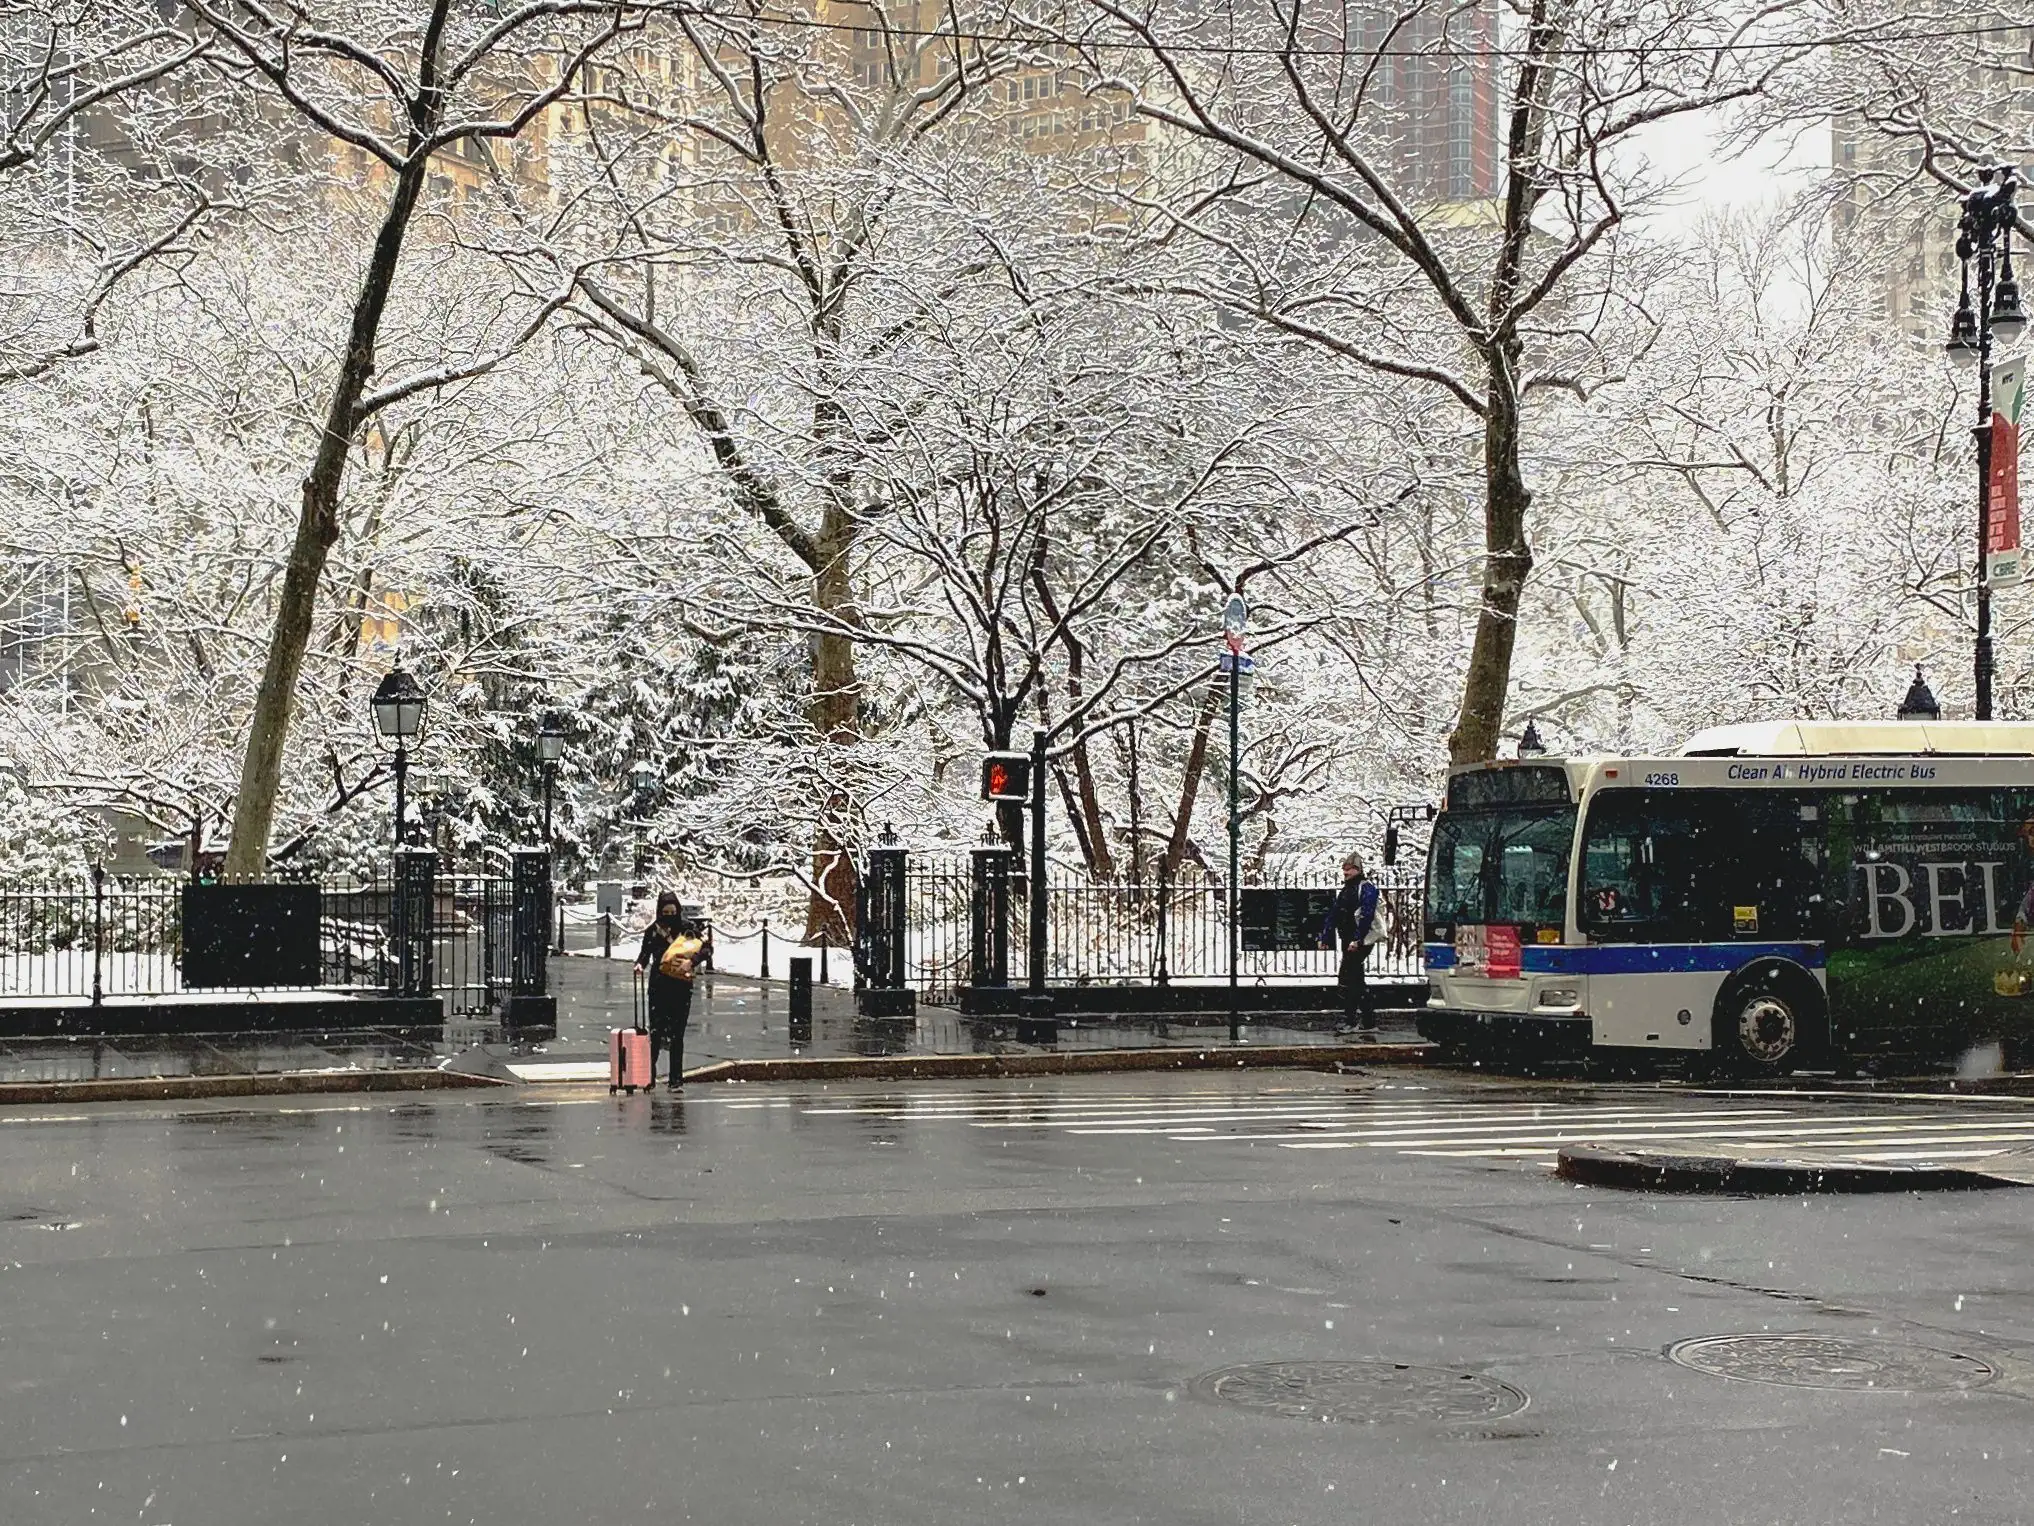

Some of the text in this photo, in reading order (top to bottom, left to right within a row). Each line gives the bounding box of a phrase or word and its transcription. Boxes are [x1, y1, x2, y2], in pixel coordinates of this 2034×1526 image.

[1992, 560, 2017, 577] CBRE
[1644, 772, 1679, 786] 4268
[1727, 764, 1768, 779] Clean
[1798, 764, 1847, 783] Hybrid
[1851, 763, 1905, 779] Electric
[1910, 764, 1936, 779] Bus
[1915, 842, 1973, 853] WESTBROOK
[1976, 840, 2016, 852] STUDIOS
[1855, 861, 2034, 939] BEL
